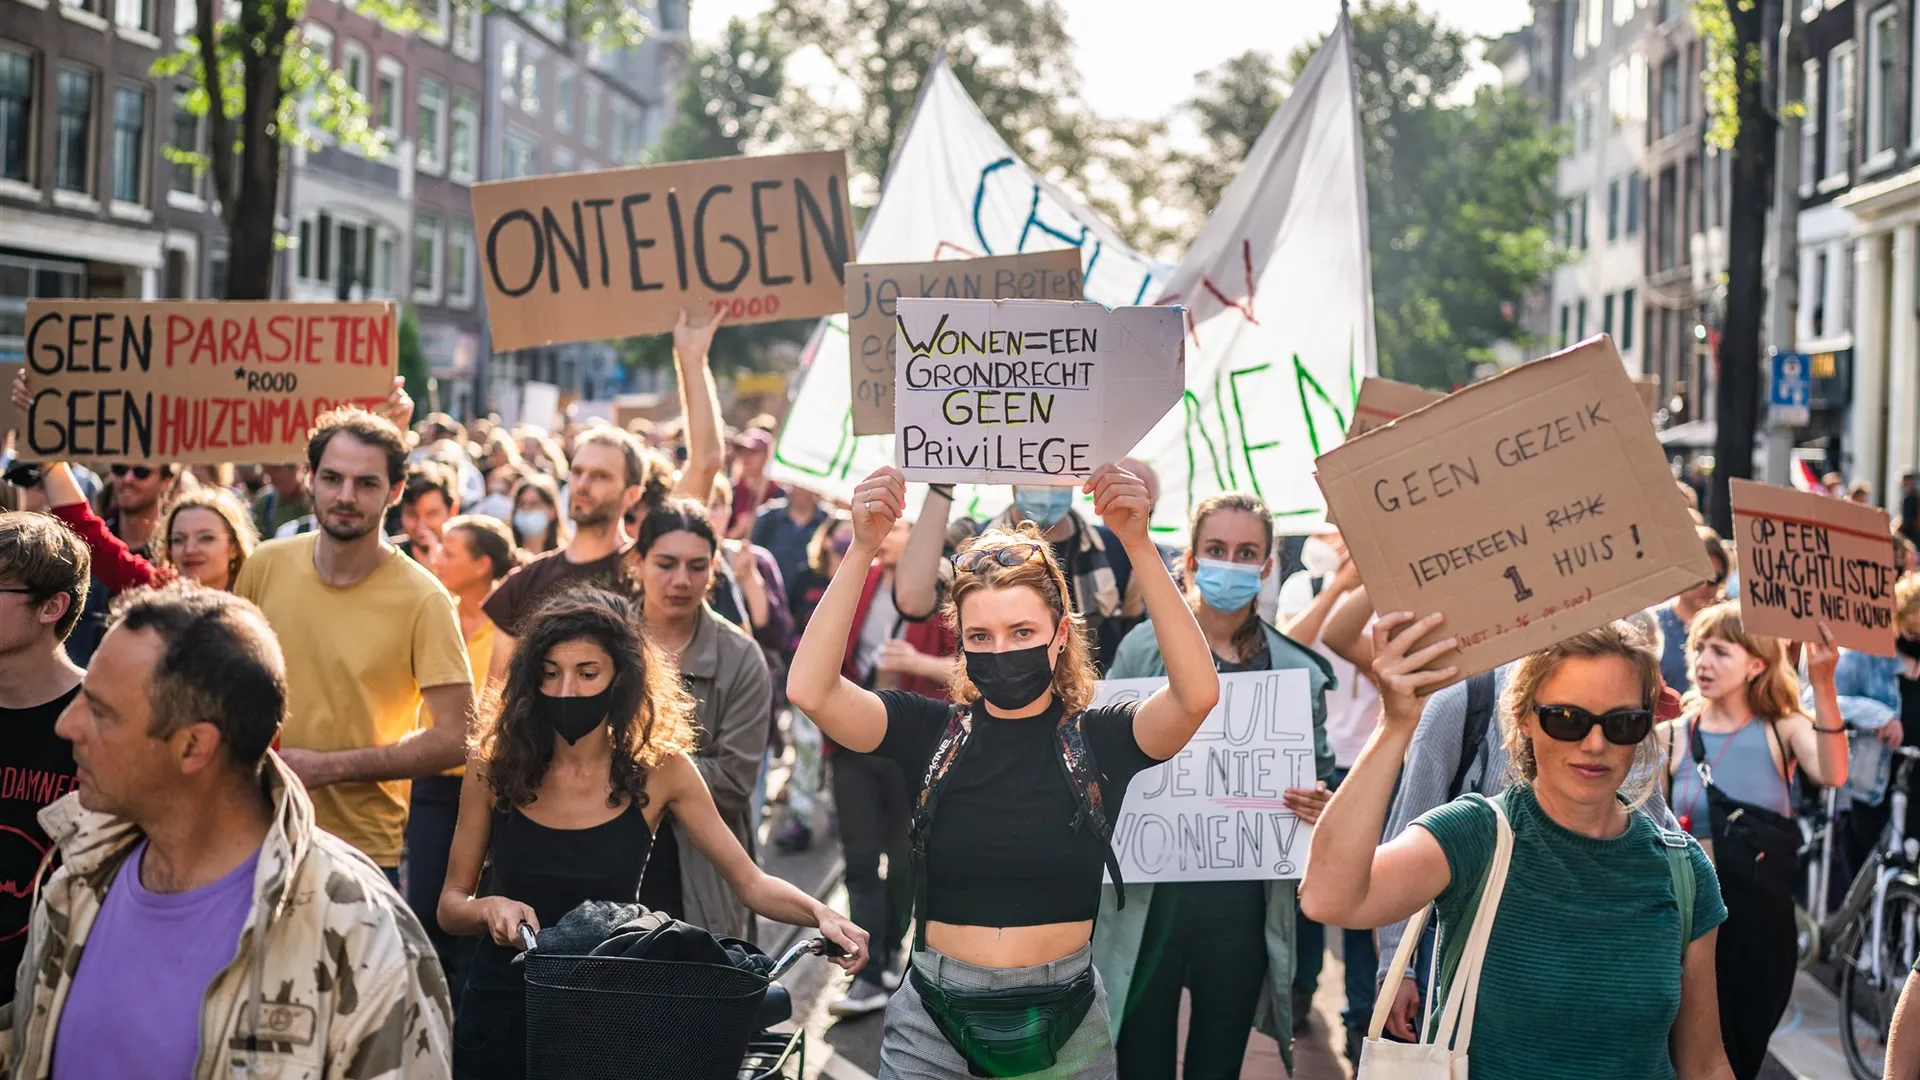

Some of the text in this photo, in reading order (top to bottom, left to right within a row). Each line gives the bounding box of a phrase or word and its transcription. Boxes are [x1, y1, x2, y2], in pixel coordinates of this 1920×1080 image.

[486, 173, 849, 298] ONTEIGEN
[919, 273, 982, 298] KAN
[27, 311, 391, 376] GEEN PARASIETEN
[905, 354, 1095, 388] GRONDRECHT
[27, 387, 153, 459] GEEN
[942, 389, 1055, 425] GEEN
[1374, 401, 1611, 513] GEEN GEZEIK
[1409, 524, 1528, 590] IEDEREEN
[1751, 517, 1831, 554] OP EEN
[1502, 565, 1533, 603] 1
[1553, 534, 1614, 577] HUIS
[1749, 578, 1787, 610] KUN
[1790, 588, 1814, 619] JE
[1206, 746, 1312, 798] NIET
